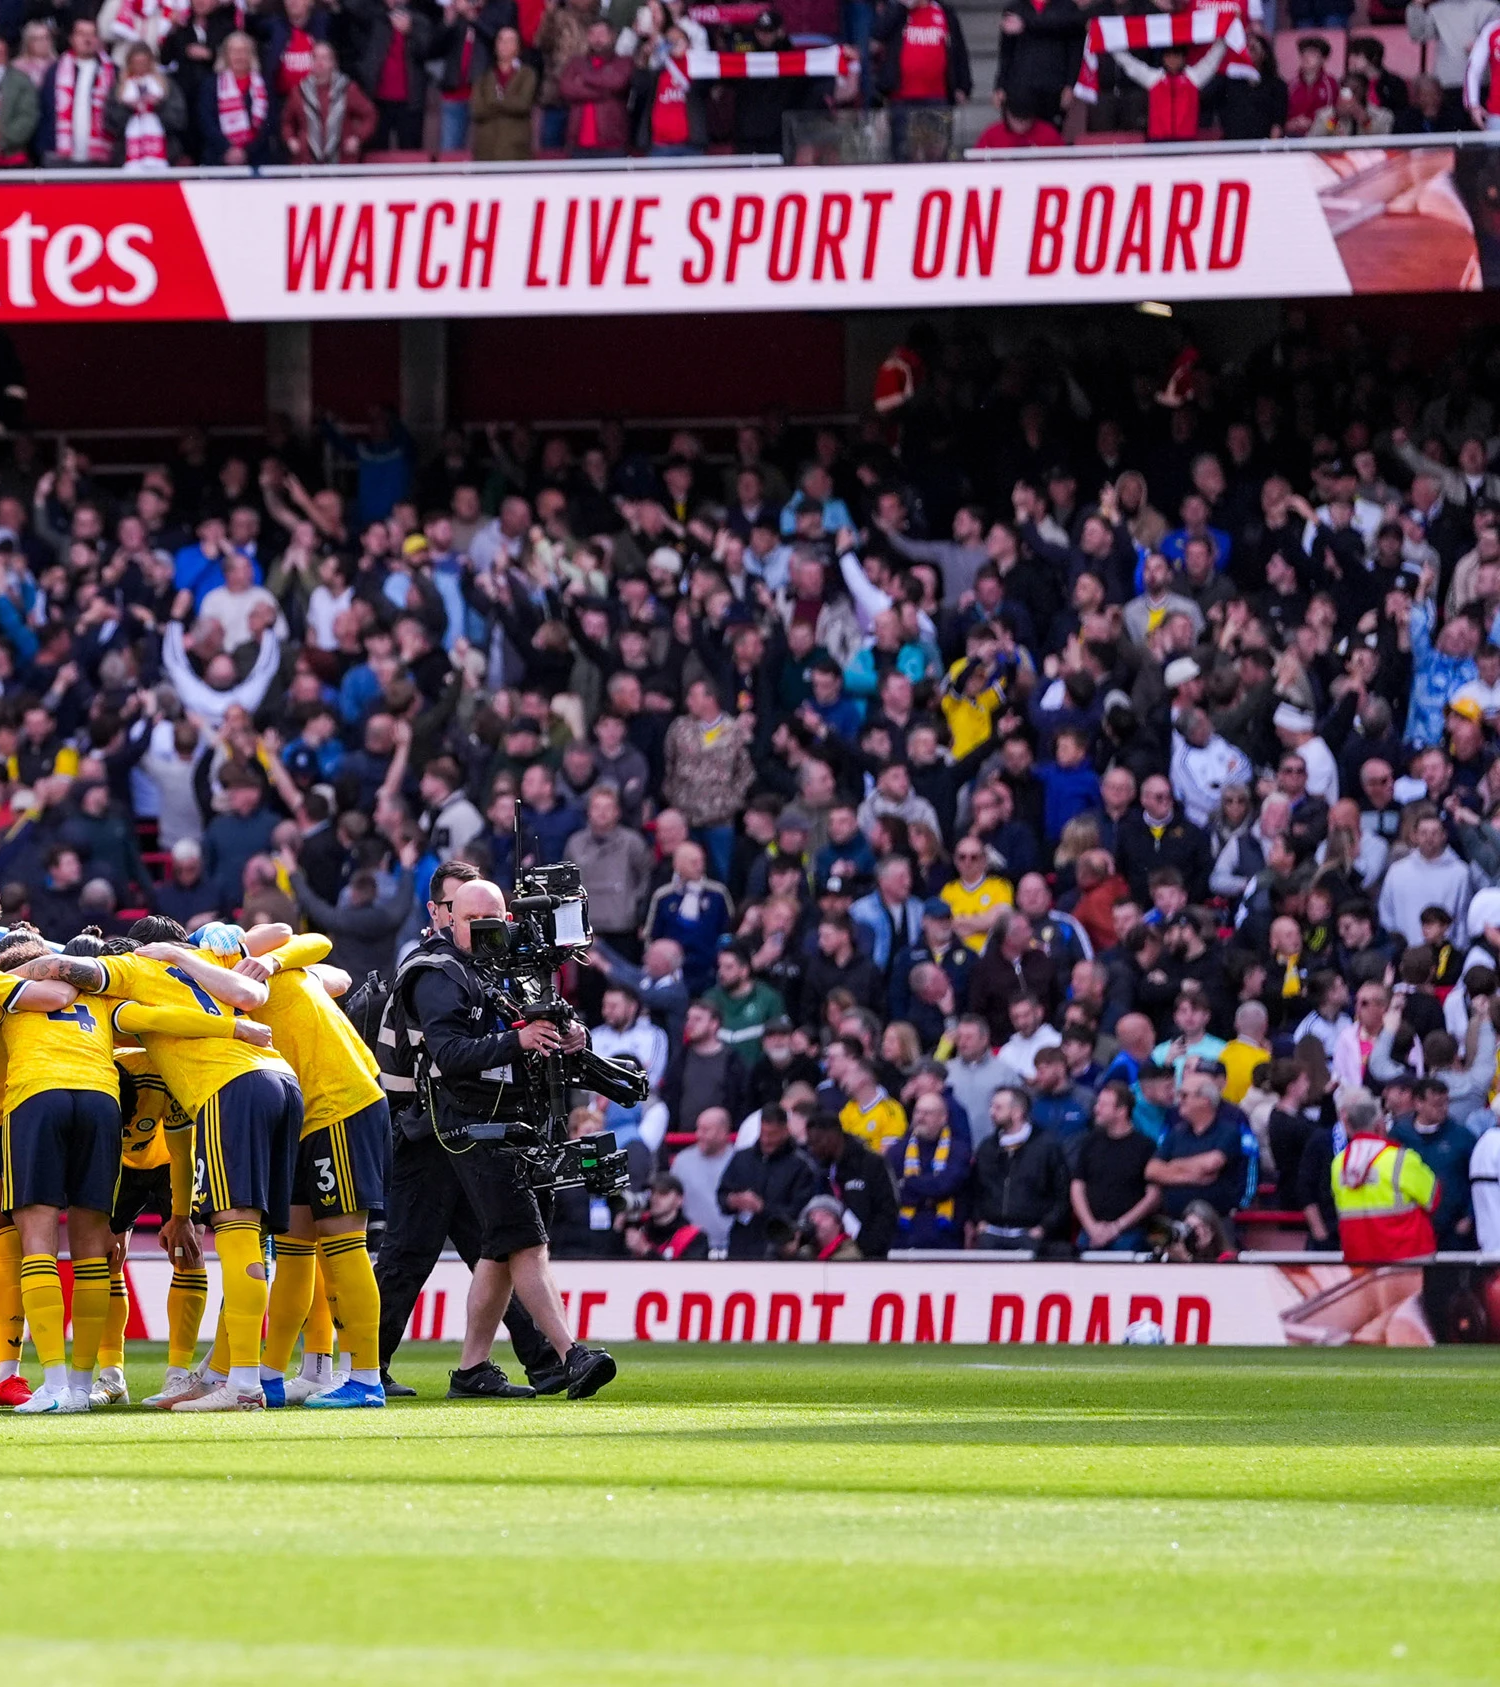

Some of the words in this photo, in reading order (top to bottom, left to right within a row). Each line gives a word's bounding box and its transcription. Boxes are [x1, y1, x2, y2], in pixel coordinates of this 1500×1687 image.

[286, 200, 501, 292] WATCH
[525, 197, 660, 288] LIVE
[681, 191, 894, 285] SPORT
[912, 188, 1003, 280] ON
[1028, 180, 1251, 276] BOARD
[314, 1157, 336, 1192] 3
